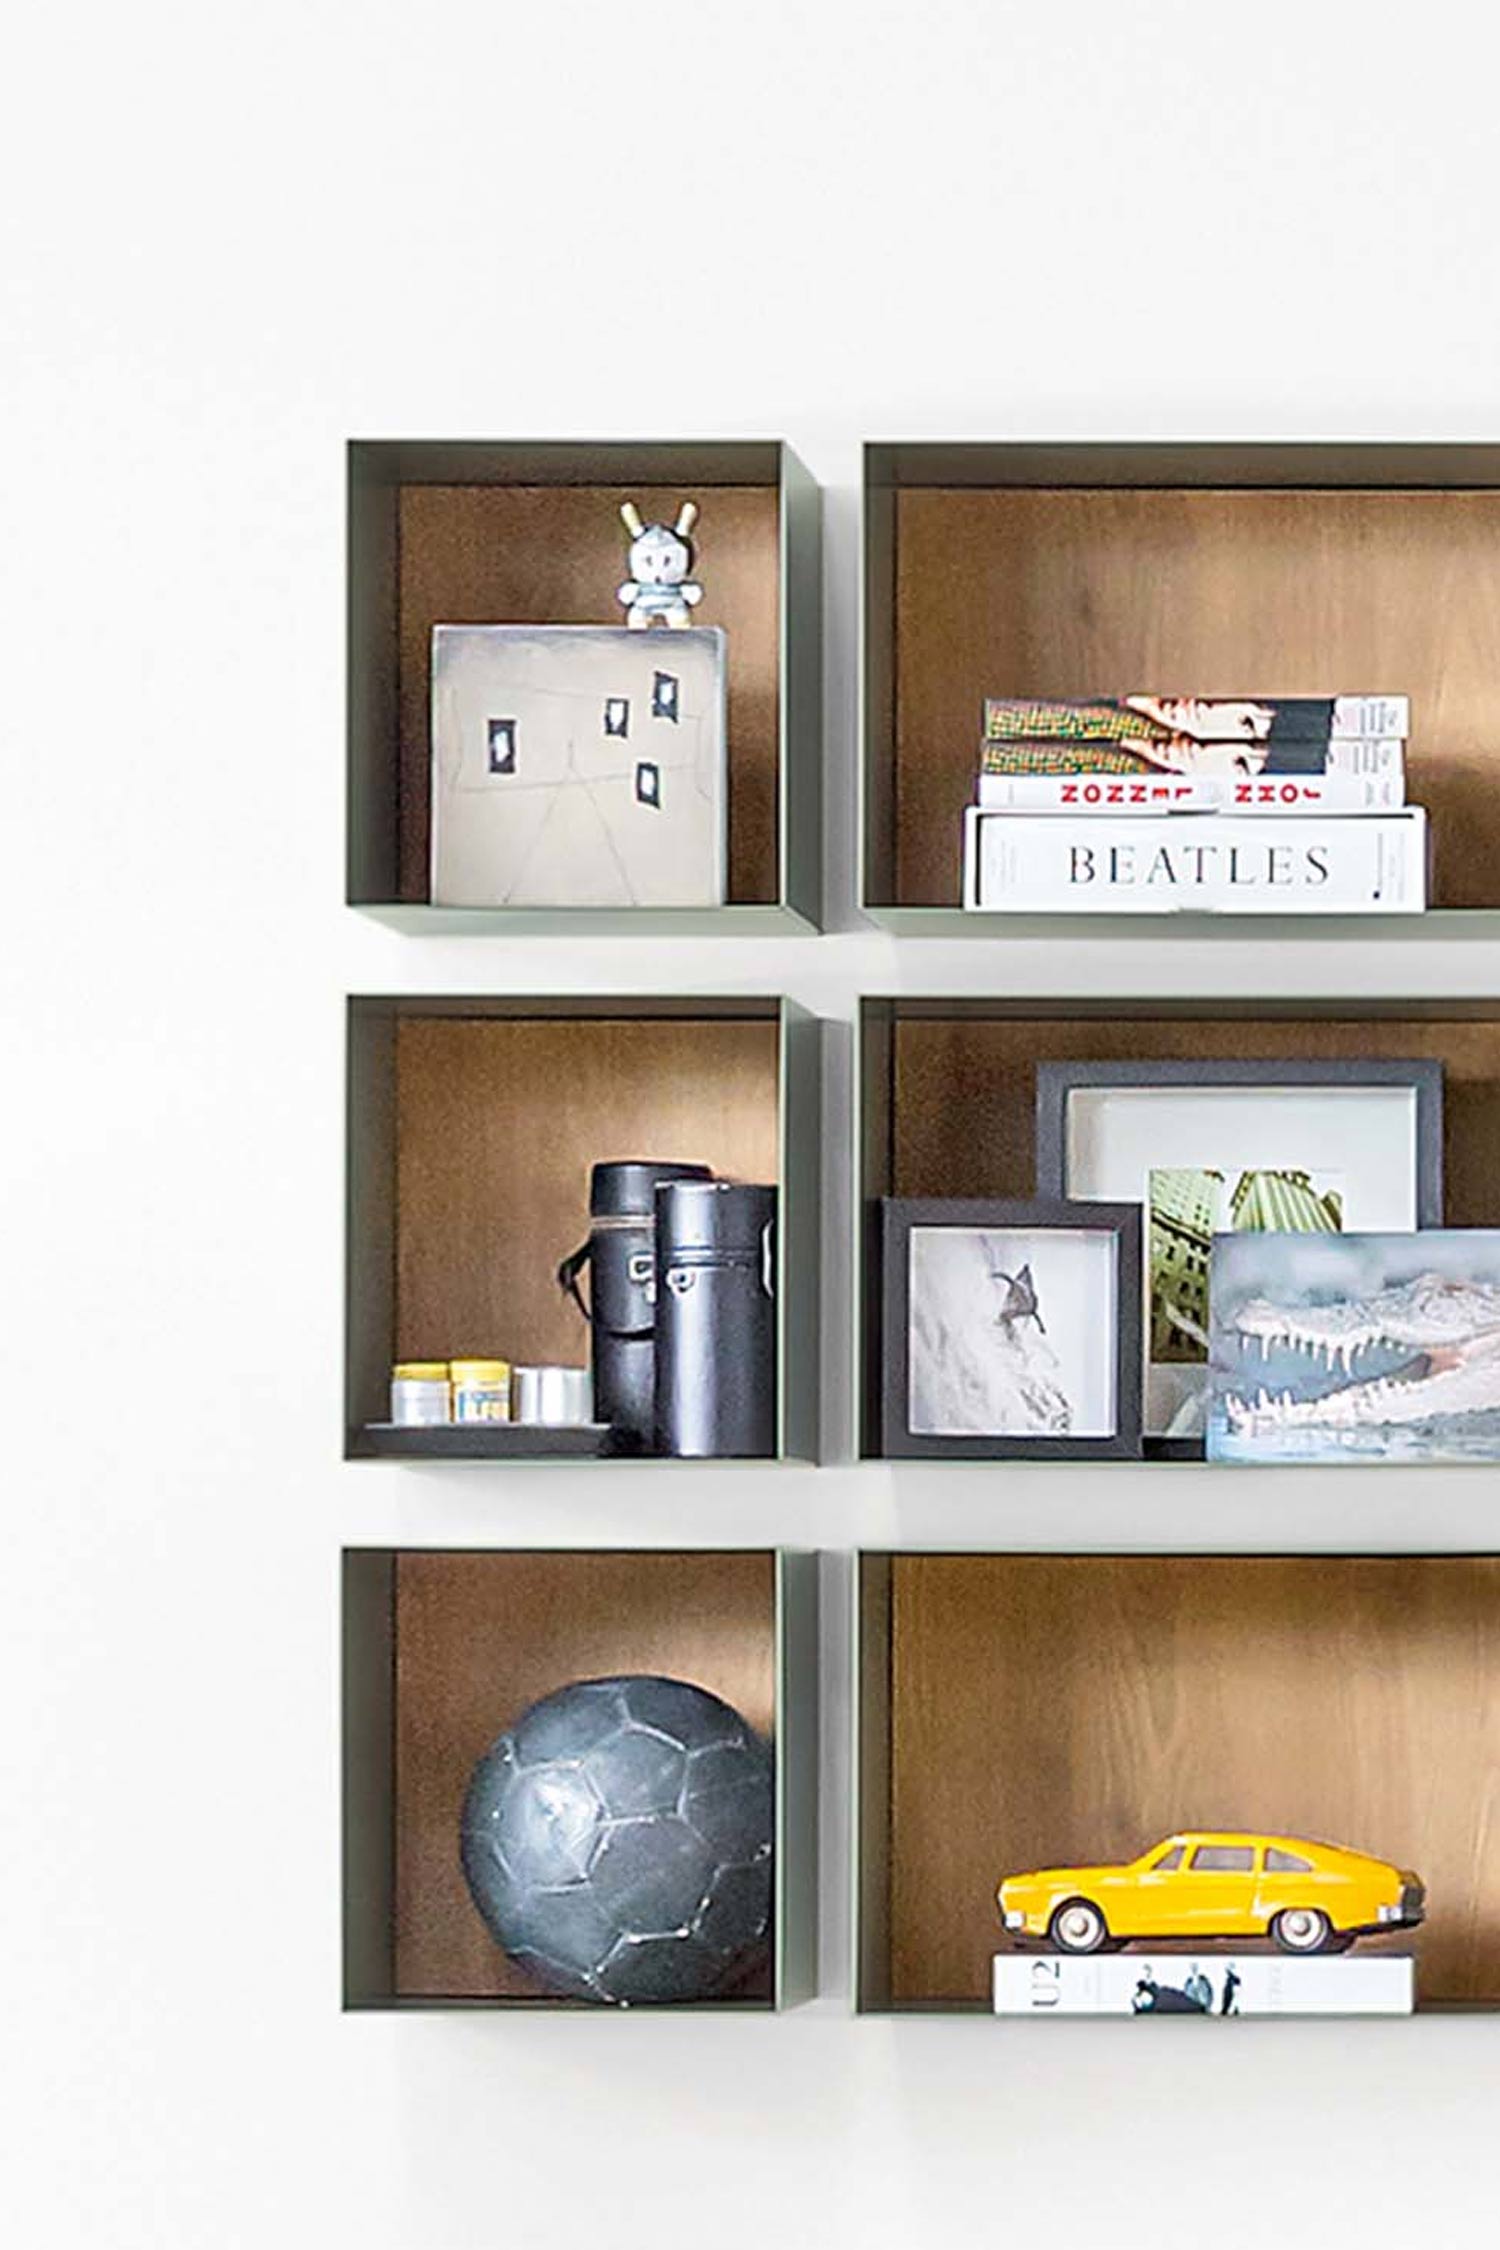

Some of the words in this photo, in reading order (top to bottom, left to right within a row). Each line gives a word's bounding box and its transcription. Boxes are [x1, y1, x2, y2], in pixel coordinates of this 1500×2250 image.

[1060, 783, 1193, 803] LENNON
[1234, 783, 1322, 803] JOHN
[1069, 845, 1329, 884] BEATLES
[1032, 1960, 1061, 2007] U2
